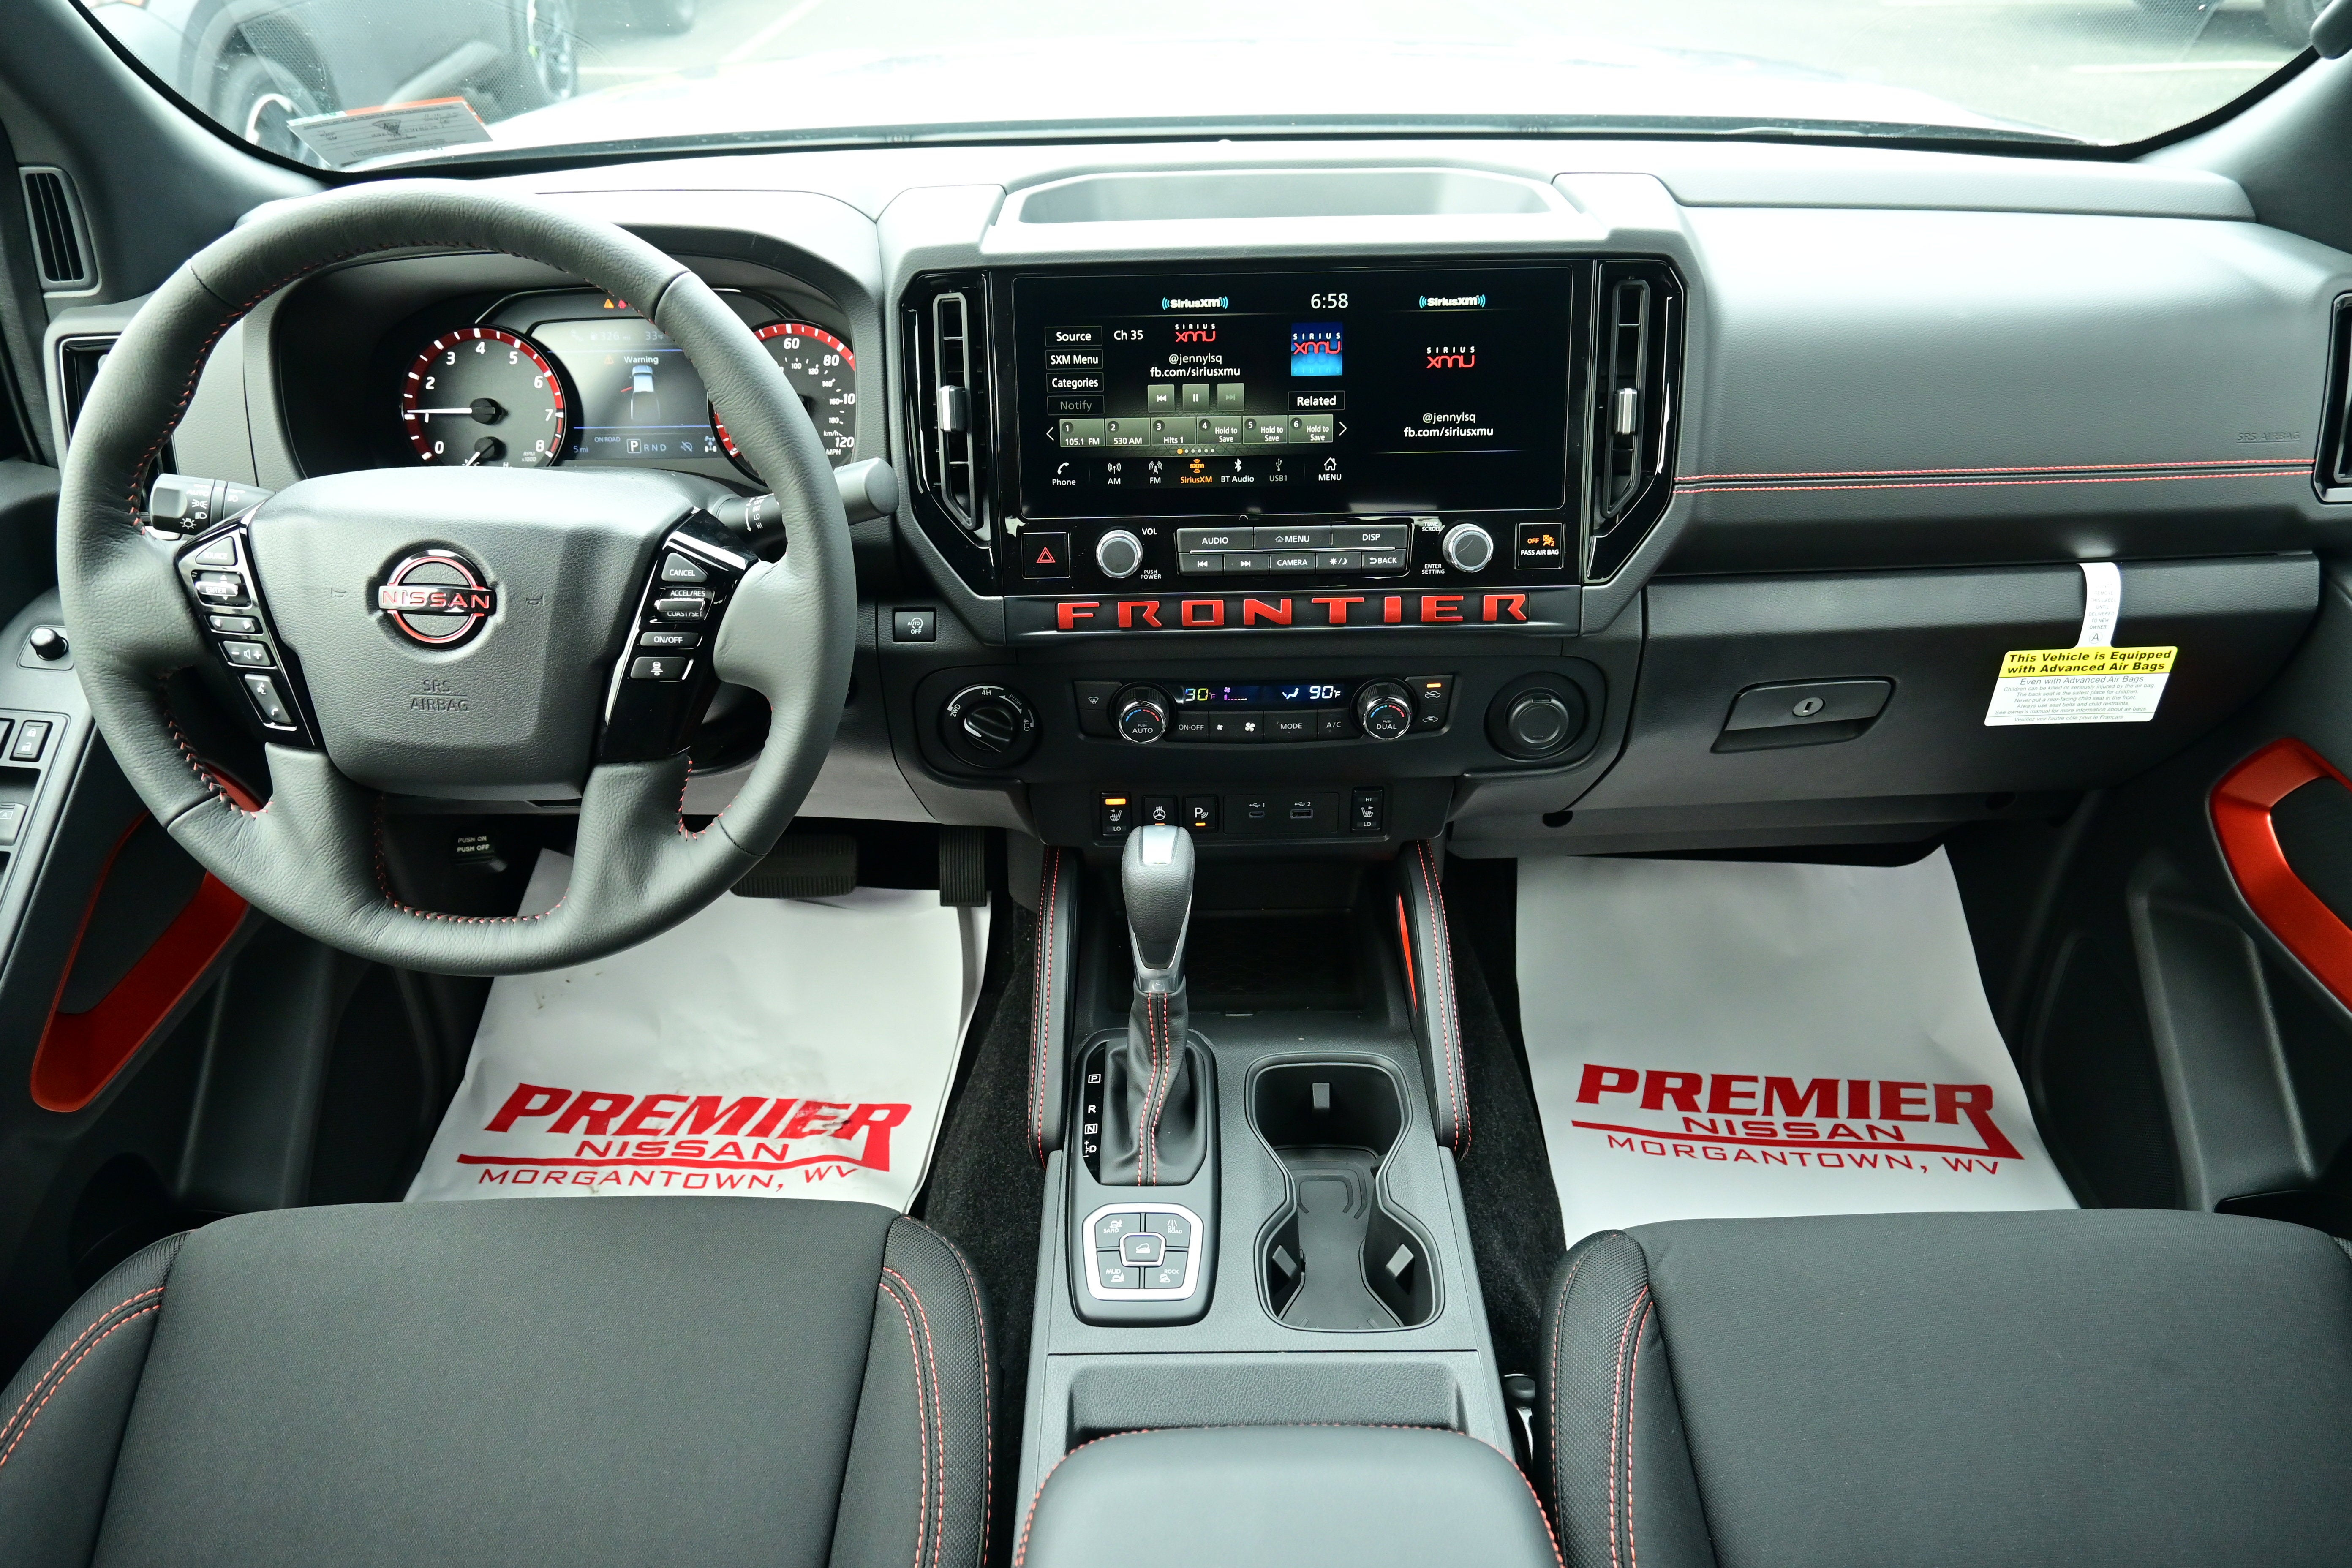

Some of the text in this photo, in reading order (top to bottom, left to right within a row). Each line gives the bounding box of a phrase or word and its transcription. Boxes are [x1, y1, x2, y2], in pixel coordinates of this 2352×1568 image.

[1311, 293, 1348, 309] 6:58
[1056, 332, 1092, 342] Source
[1114, 330, 1143, 340] Ch 35
[476, 341, 485, 354] 4
[784, 338, 800, 349] 60
[446, 351, 455, 365] 3
[509, 351, 518, 364] 5
[623, 356, 659, 365] Warning
[823, 354, 839, 366] 80
[1051, 354, 1098, 365] SXM Menu
[1168, 353, 1222, 365] @jennylsq
[1150, 367, 1240, 378] fb.com/siriusxmu
[425, 376, 435, 389] 2
[534, 376, 543, 389] 6
[1052, 378, 1098, 389] Categories
[1060, 400, 1092, 412] Notify
[1297, 395, 1337, 406] Related
[545, 408, 553, 421] 7
[1423, 412, 1475, 424] @jennylsq
[1404, 427, 1493, 437] fb.com/siriusxmu
[435, 441, 444, 454] 0
[535, 440, 544, 452] 8
[835, 437, 855, 448] 120
[186, 489, 210, 497] AUTO
[1202, 536, 1229, 544] AUDIO
[206, 586, 227, 594] ENTER
[382, 591, 490, 609] NISSAN
[1057, 594, 1527, 629] FRONTIER
[654, 636, 683, 644] ON/OFF
[2010, 650, 2172, 662] This Vehicle is Equipped
[2008, 662, 2165, 673] with Advanced Air Bags
[2122, 675, 2144, 683] Bags
[422, 679, 451, 692] SRS
[410, 698, 468, 711] AIRBAG
[1009, 694, 1023, 706] PUSH
[950, 704, 961, 718] 2WD
[1088, 1105, 1096, 1113] R
[1575, 1063, 2025, 1160] PREMIER
[484, 1083, 912, 1172] PREMIER
[1682, 1116, 1906, 1143] NISSAN
[574, 1140, 790, 1162] NISSAN
[1089, 1145, 1097, 1153] D
[1606, 1134, 1999, 1175] MORGANTOWN, WV
[478, 1166, 860, 1192] MORGANTOWN, WV
